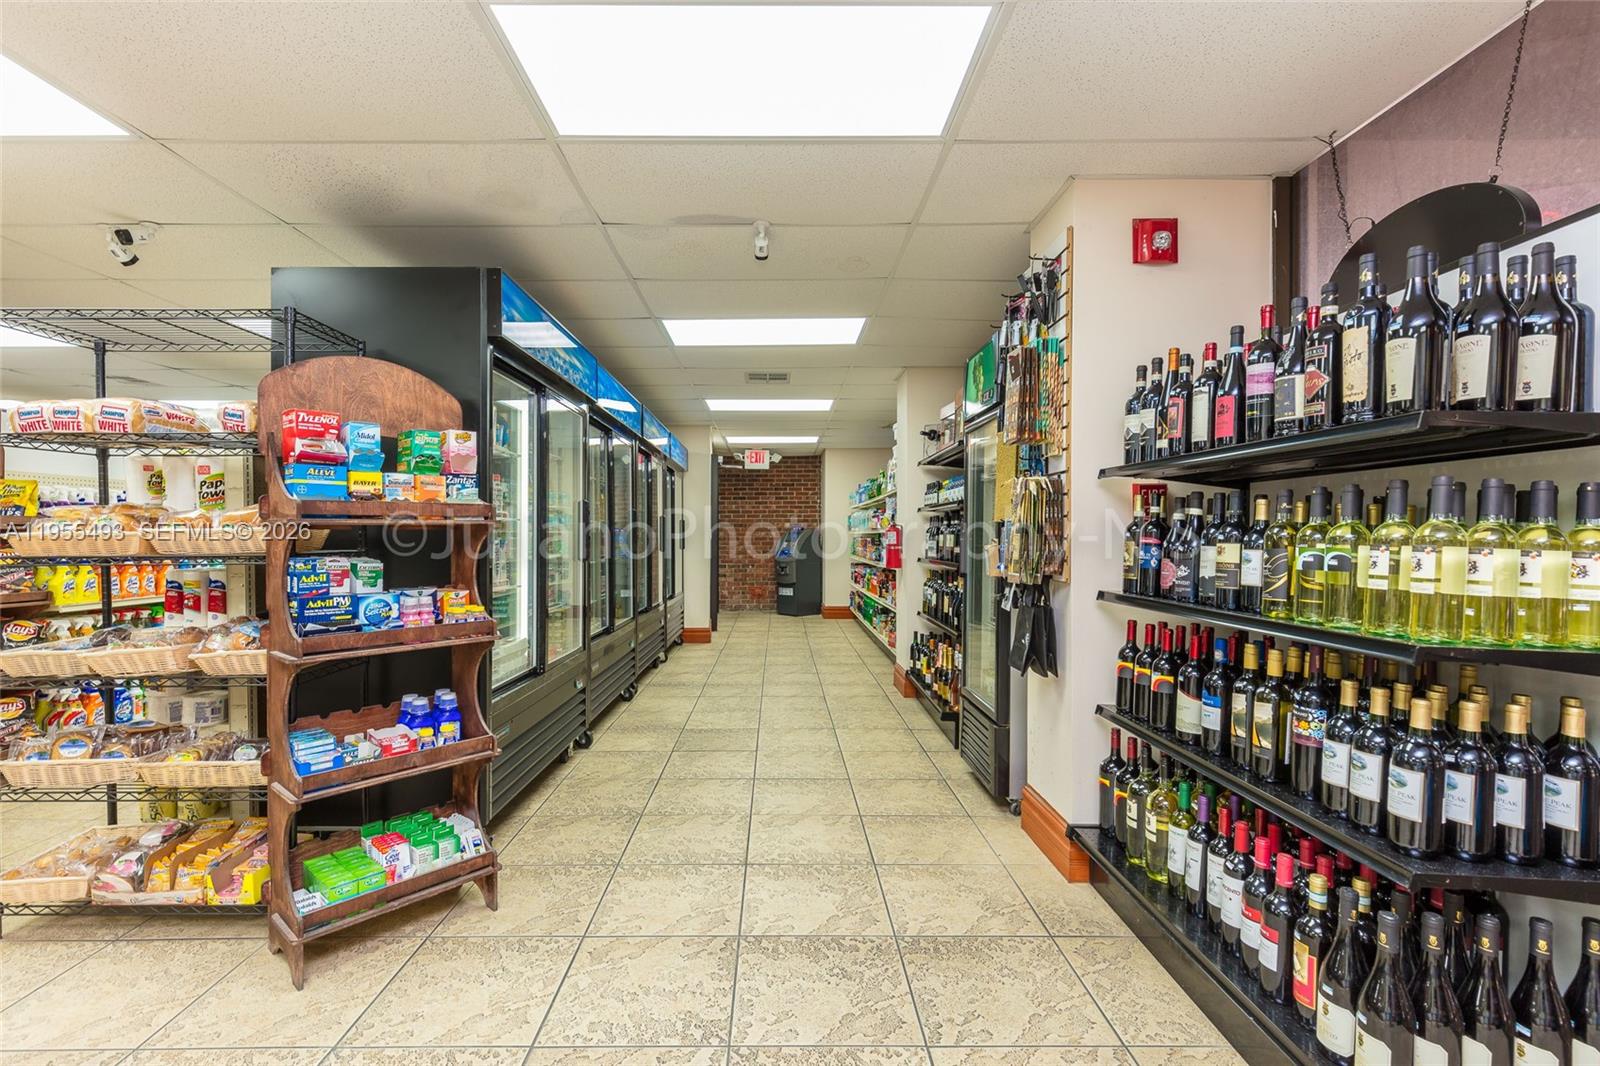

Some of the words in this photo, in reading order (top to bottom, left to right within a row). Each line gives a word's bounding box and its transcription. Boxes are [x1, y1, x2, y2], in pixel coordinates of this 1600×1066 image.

[297, 412, 338, 425] TYLENOL
[18, 419, 49, 432] WHITE
[52, 420, 83, 431] WHITE
[98, 420, 129, 433] WHITE
[356, 431, 376, 440] Midol
[750, 451, 765, 464] EXIT
[306, 467, 336, 476] ALEVE
[446, 474, 477, 486] Zantac
[300, 574, 327, 584] Advil
[306, 599, 334, 609] Advil
[333, 596, 348, 607] PM
[0, 701, 23, 712] ays
[1397, 790, 1416, 800] PEAK
